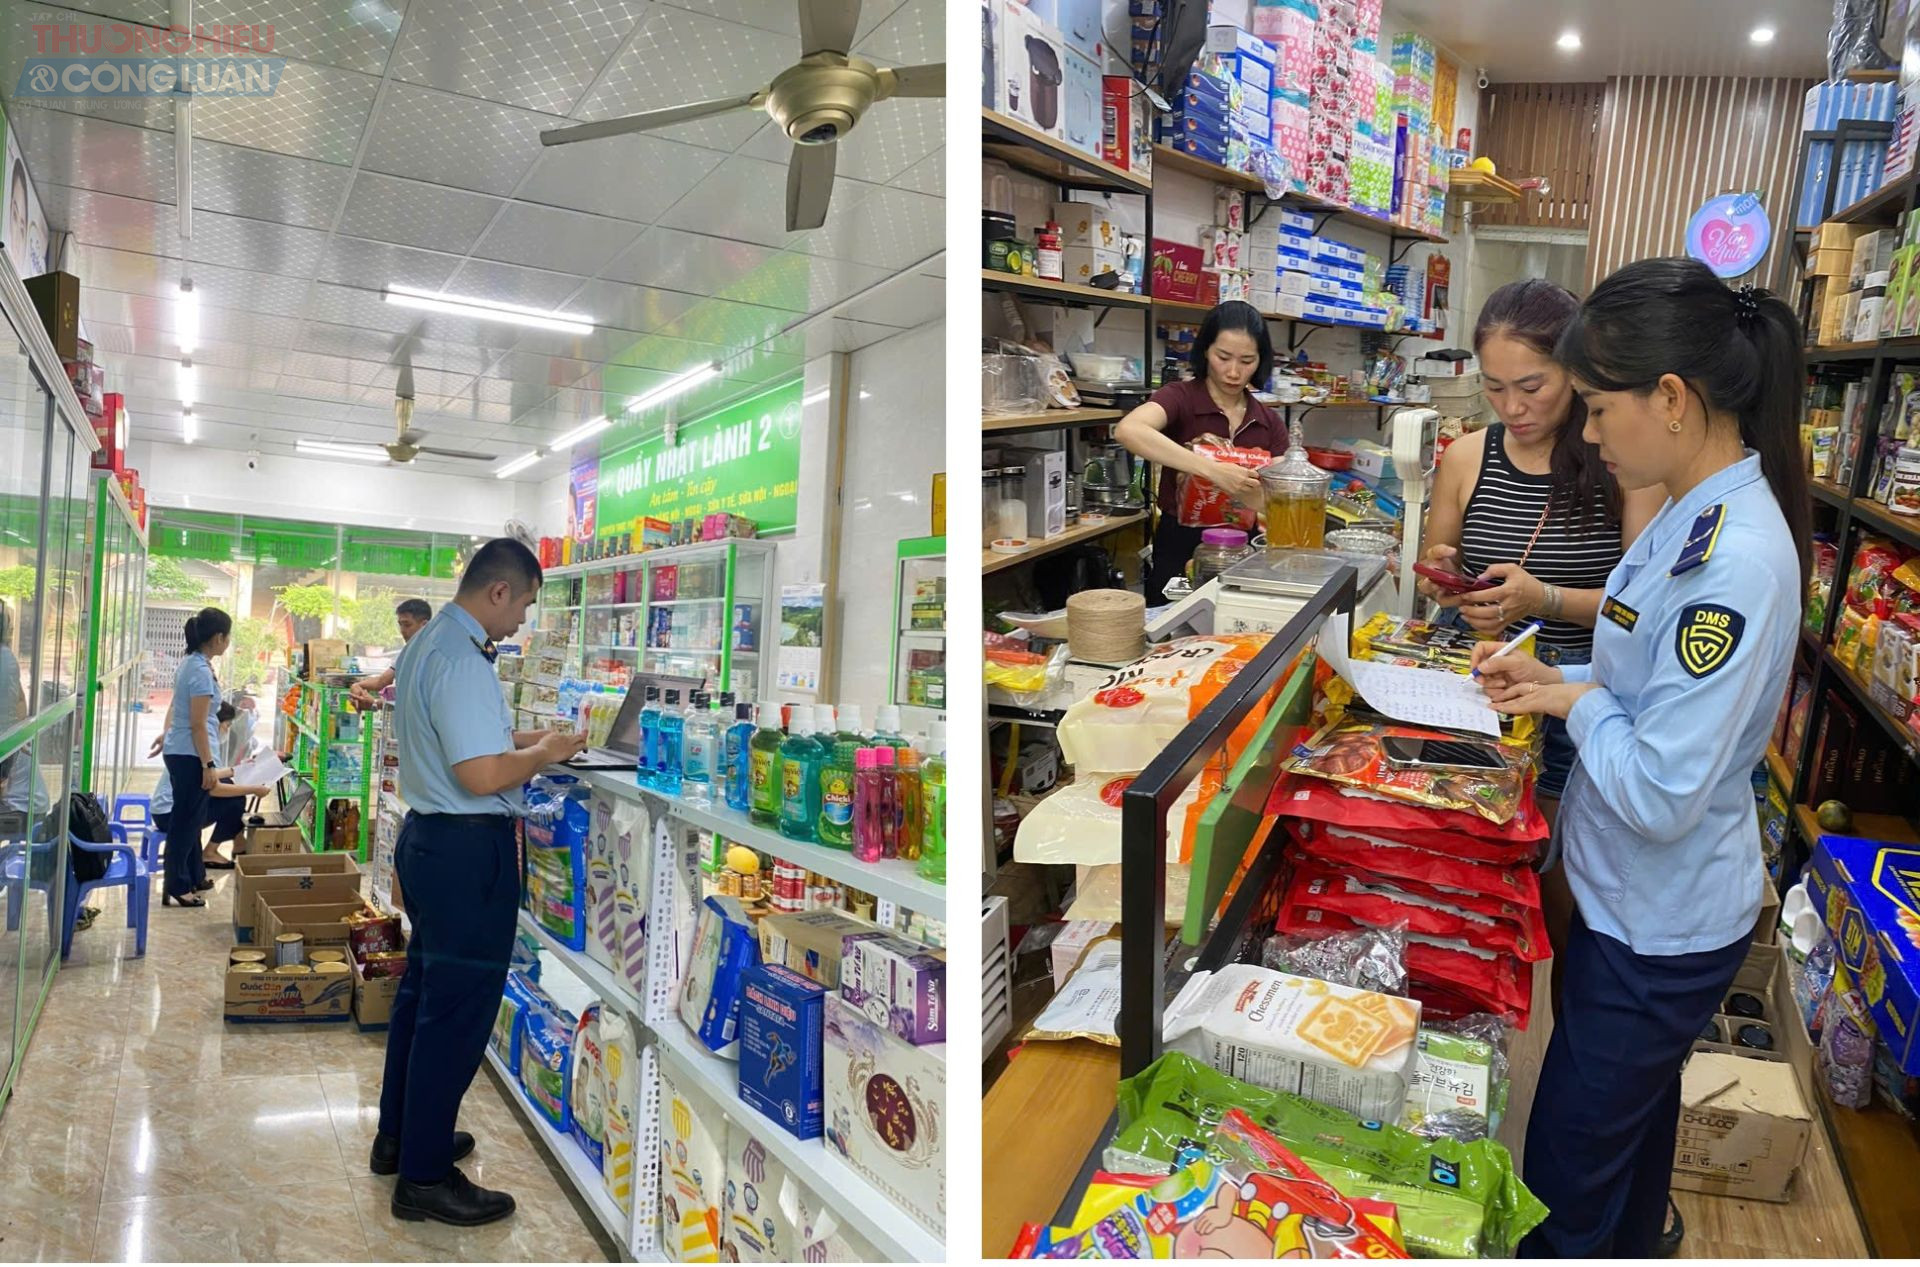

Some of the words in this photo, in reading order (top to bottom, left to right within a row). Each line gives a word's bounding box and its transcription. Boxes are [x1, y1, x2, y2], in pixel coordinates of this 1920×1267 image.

[655, 438, 698, 483] NHẬT
[702, 423, 752, 468] LÀNH
[758, 414, 772, 451] 2
[1695, 610, 1731, 628] DMS
[1248, 980, 1282, 1022] Chessmen
[927, 1009, 939, 1031] Sâm
[1237, 1047, 1246, 1062] 120
